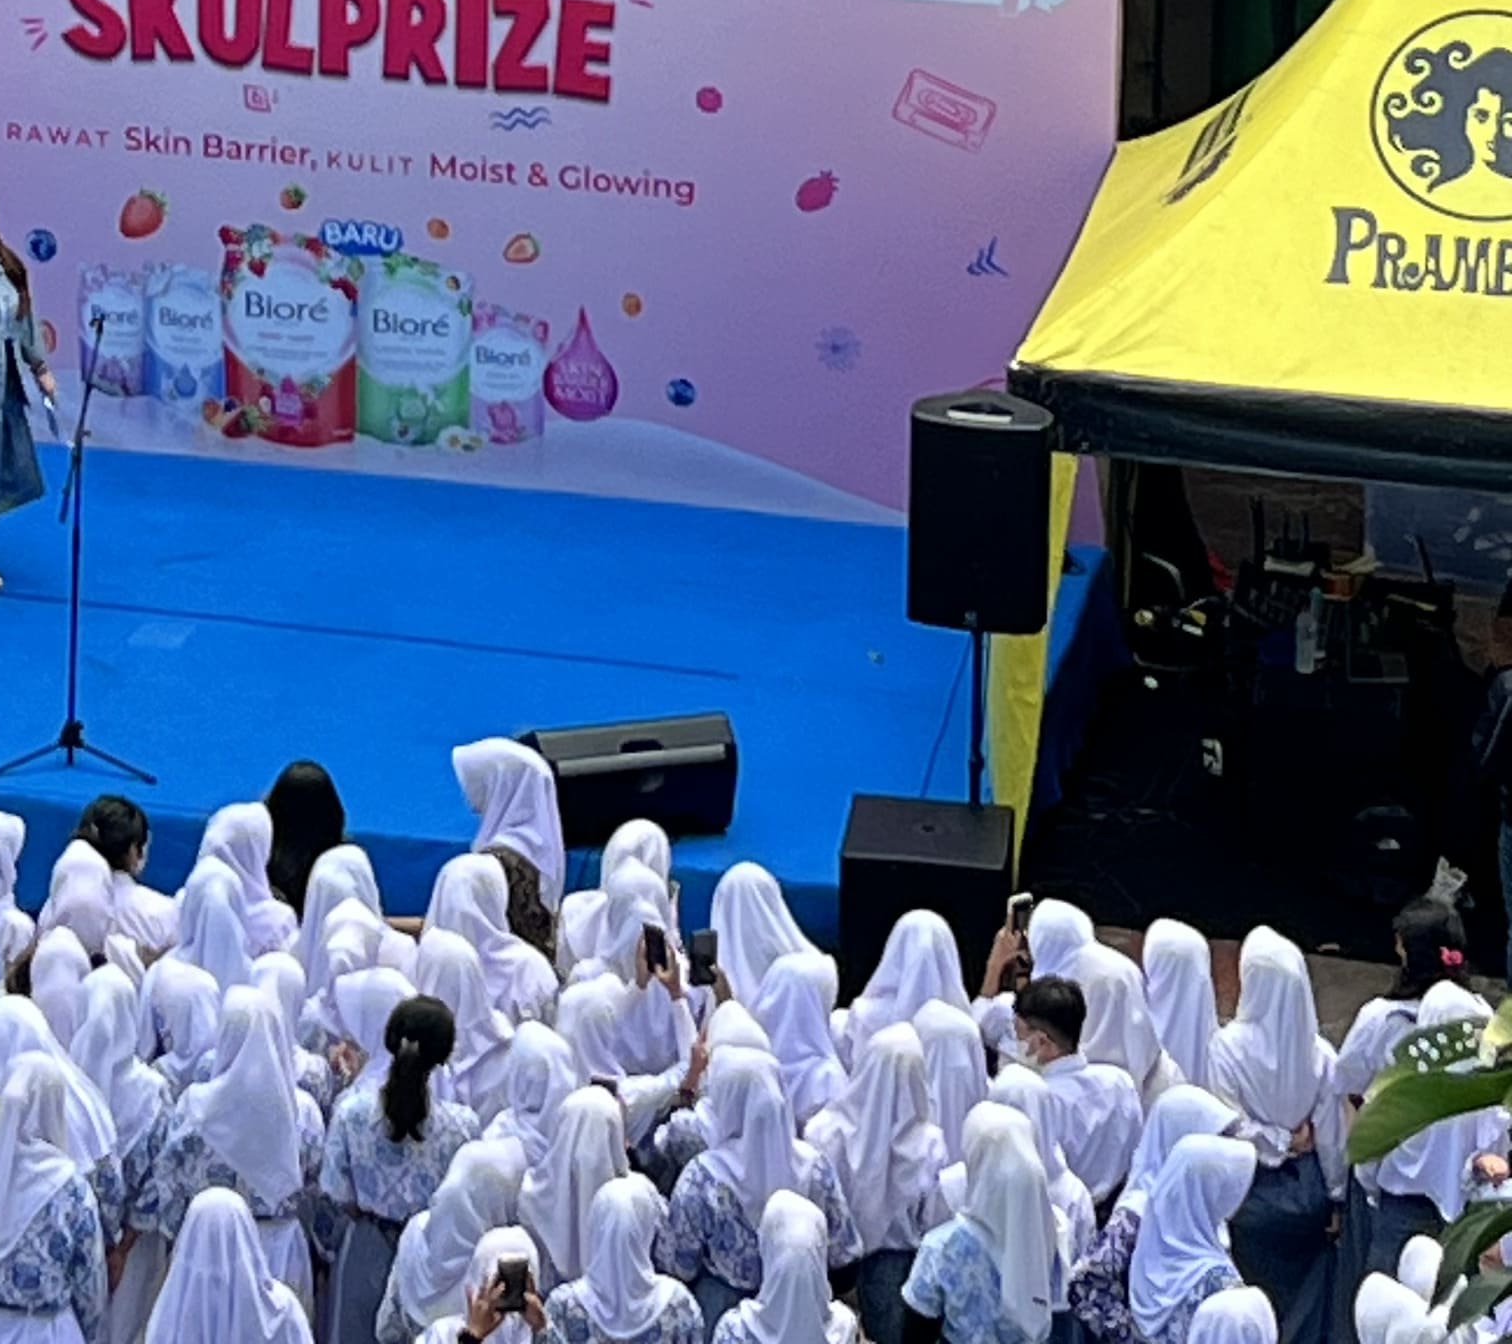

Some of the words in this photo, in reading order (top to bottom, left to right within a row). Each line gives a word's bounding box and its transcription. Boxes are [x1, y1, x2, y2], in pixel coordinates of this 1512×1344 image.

[6, 121, 111, 149] RAWAT
[124, 125, 192, 158] Skin
[202, 132, 318, 172] Barrier,
[326, 149, 414, 177] KULIT
[429, 151, 519, 186] Moist
[526, 161, 550, 188] &
[557, 163, 697, 208] Glowing
[323, 220, 400, 252] BARU
[244, 290, 330, 323] Bioré
[372, 308, 451, 338] Bioré
